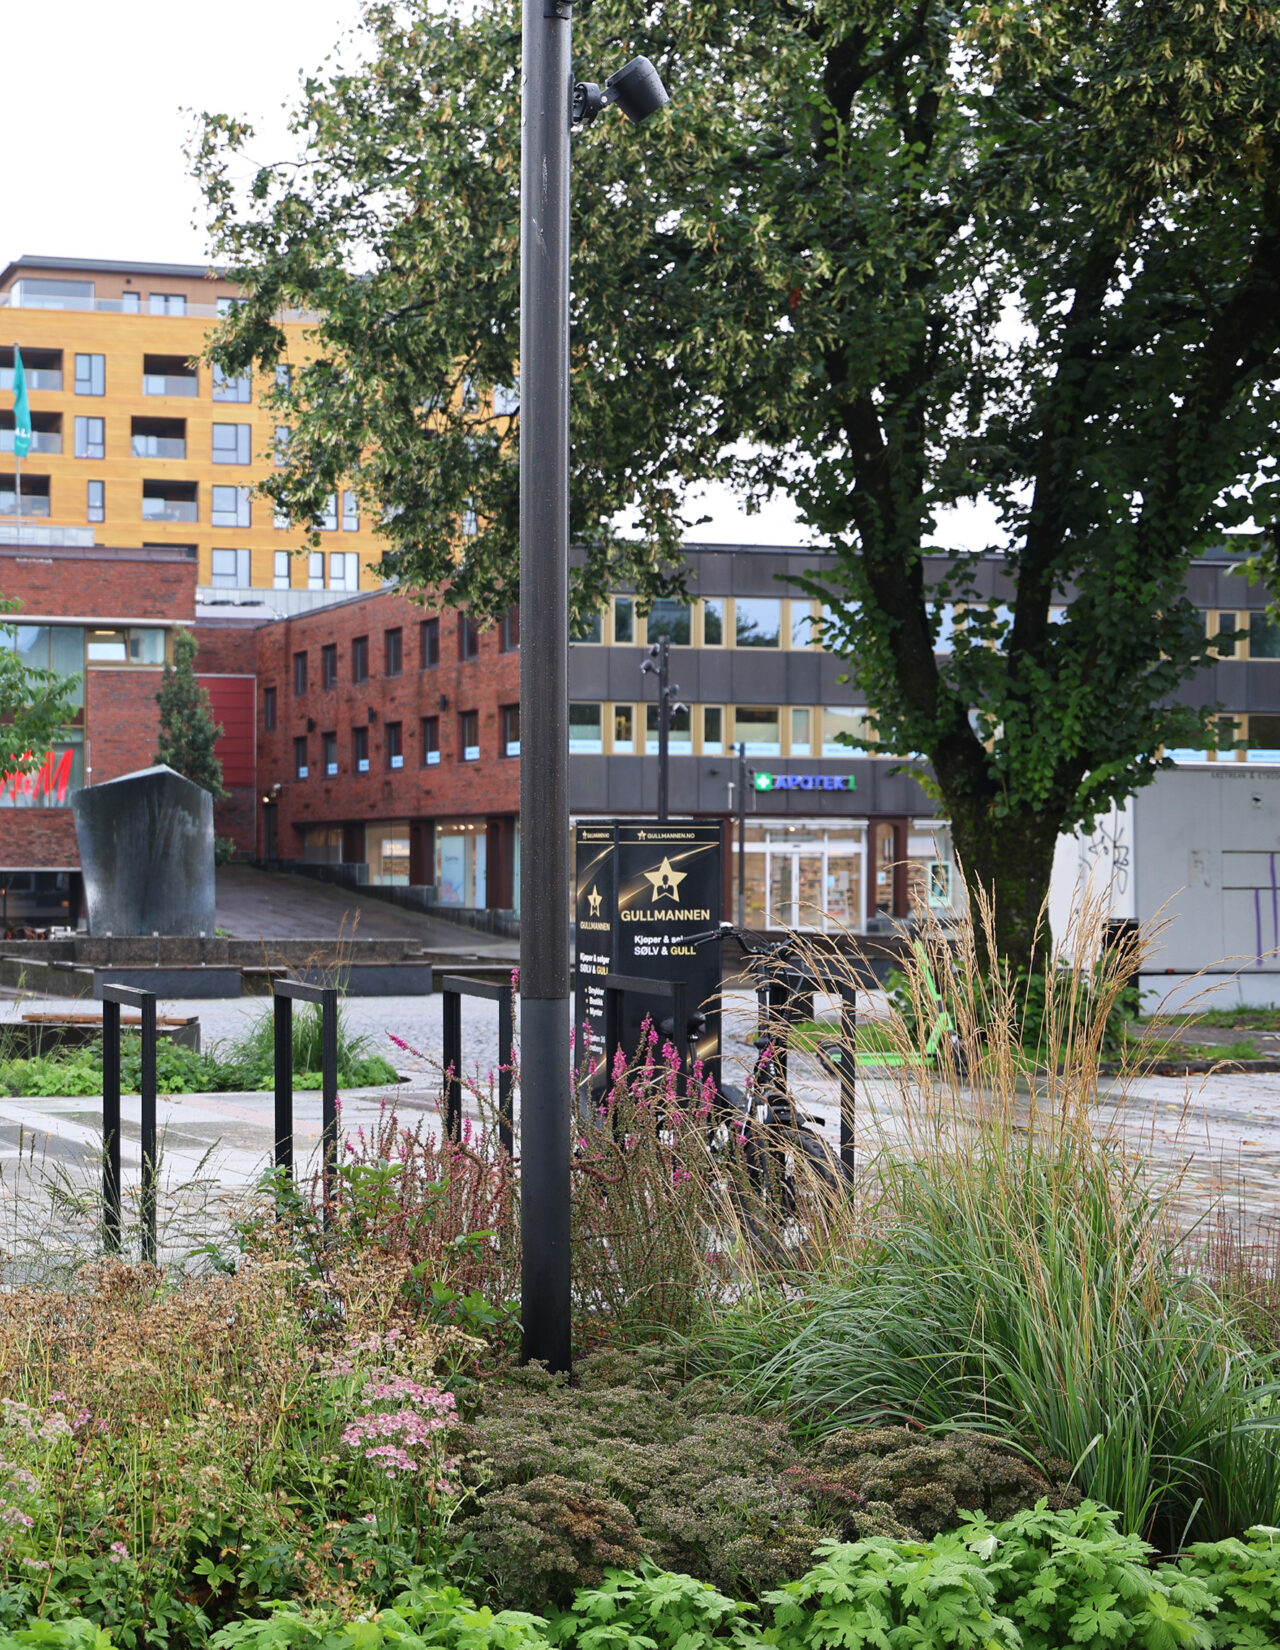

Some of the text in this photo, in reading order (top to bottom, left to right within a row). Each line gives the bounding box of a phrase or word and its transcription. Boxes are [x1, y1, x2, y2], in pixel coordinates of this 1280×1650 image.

[776, 775, 845, 790] APOTEK
[647, 832, 696, 840] GULLMANNEN.NO
[621, 909, 710, 921] GULLMANNEN
[580, 921, 611, 931] GULLMANNEN
[634, 935, 662, 945] Kjøper
[663, 935, 670, 943] &
[634, 946, 696, 955] SØLV & GULL
